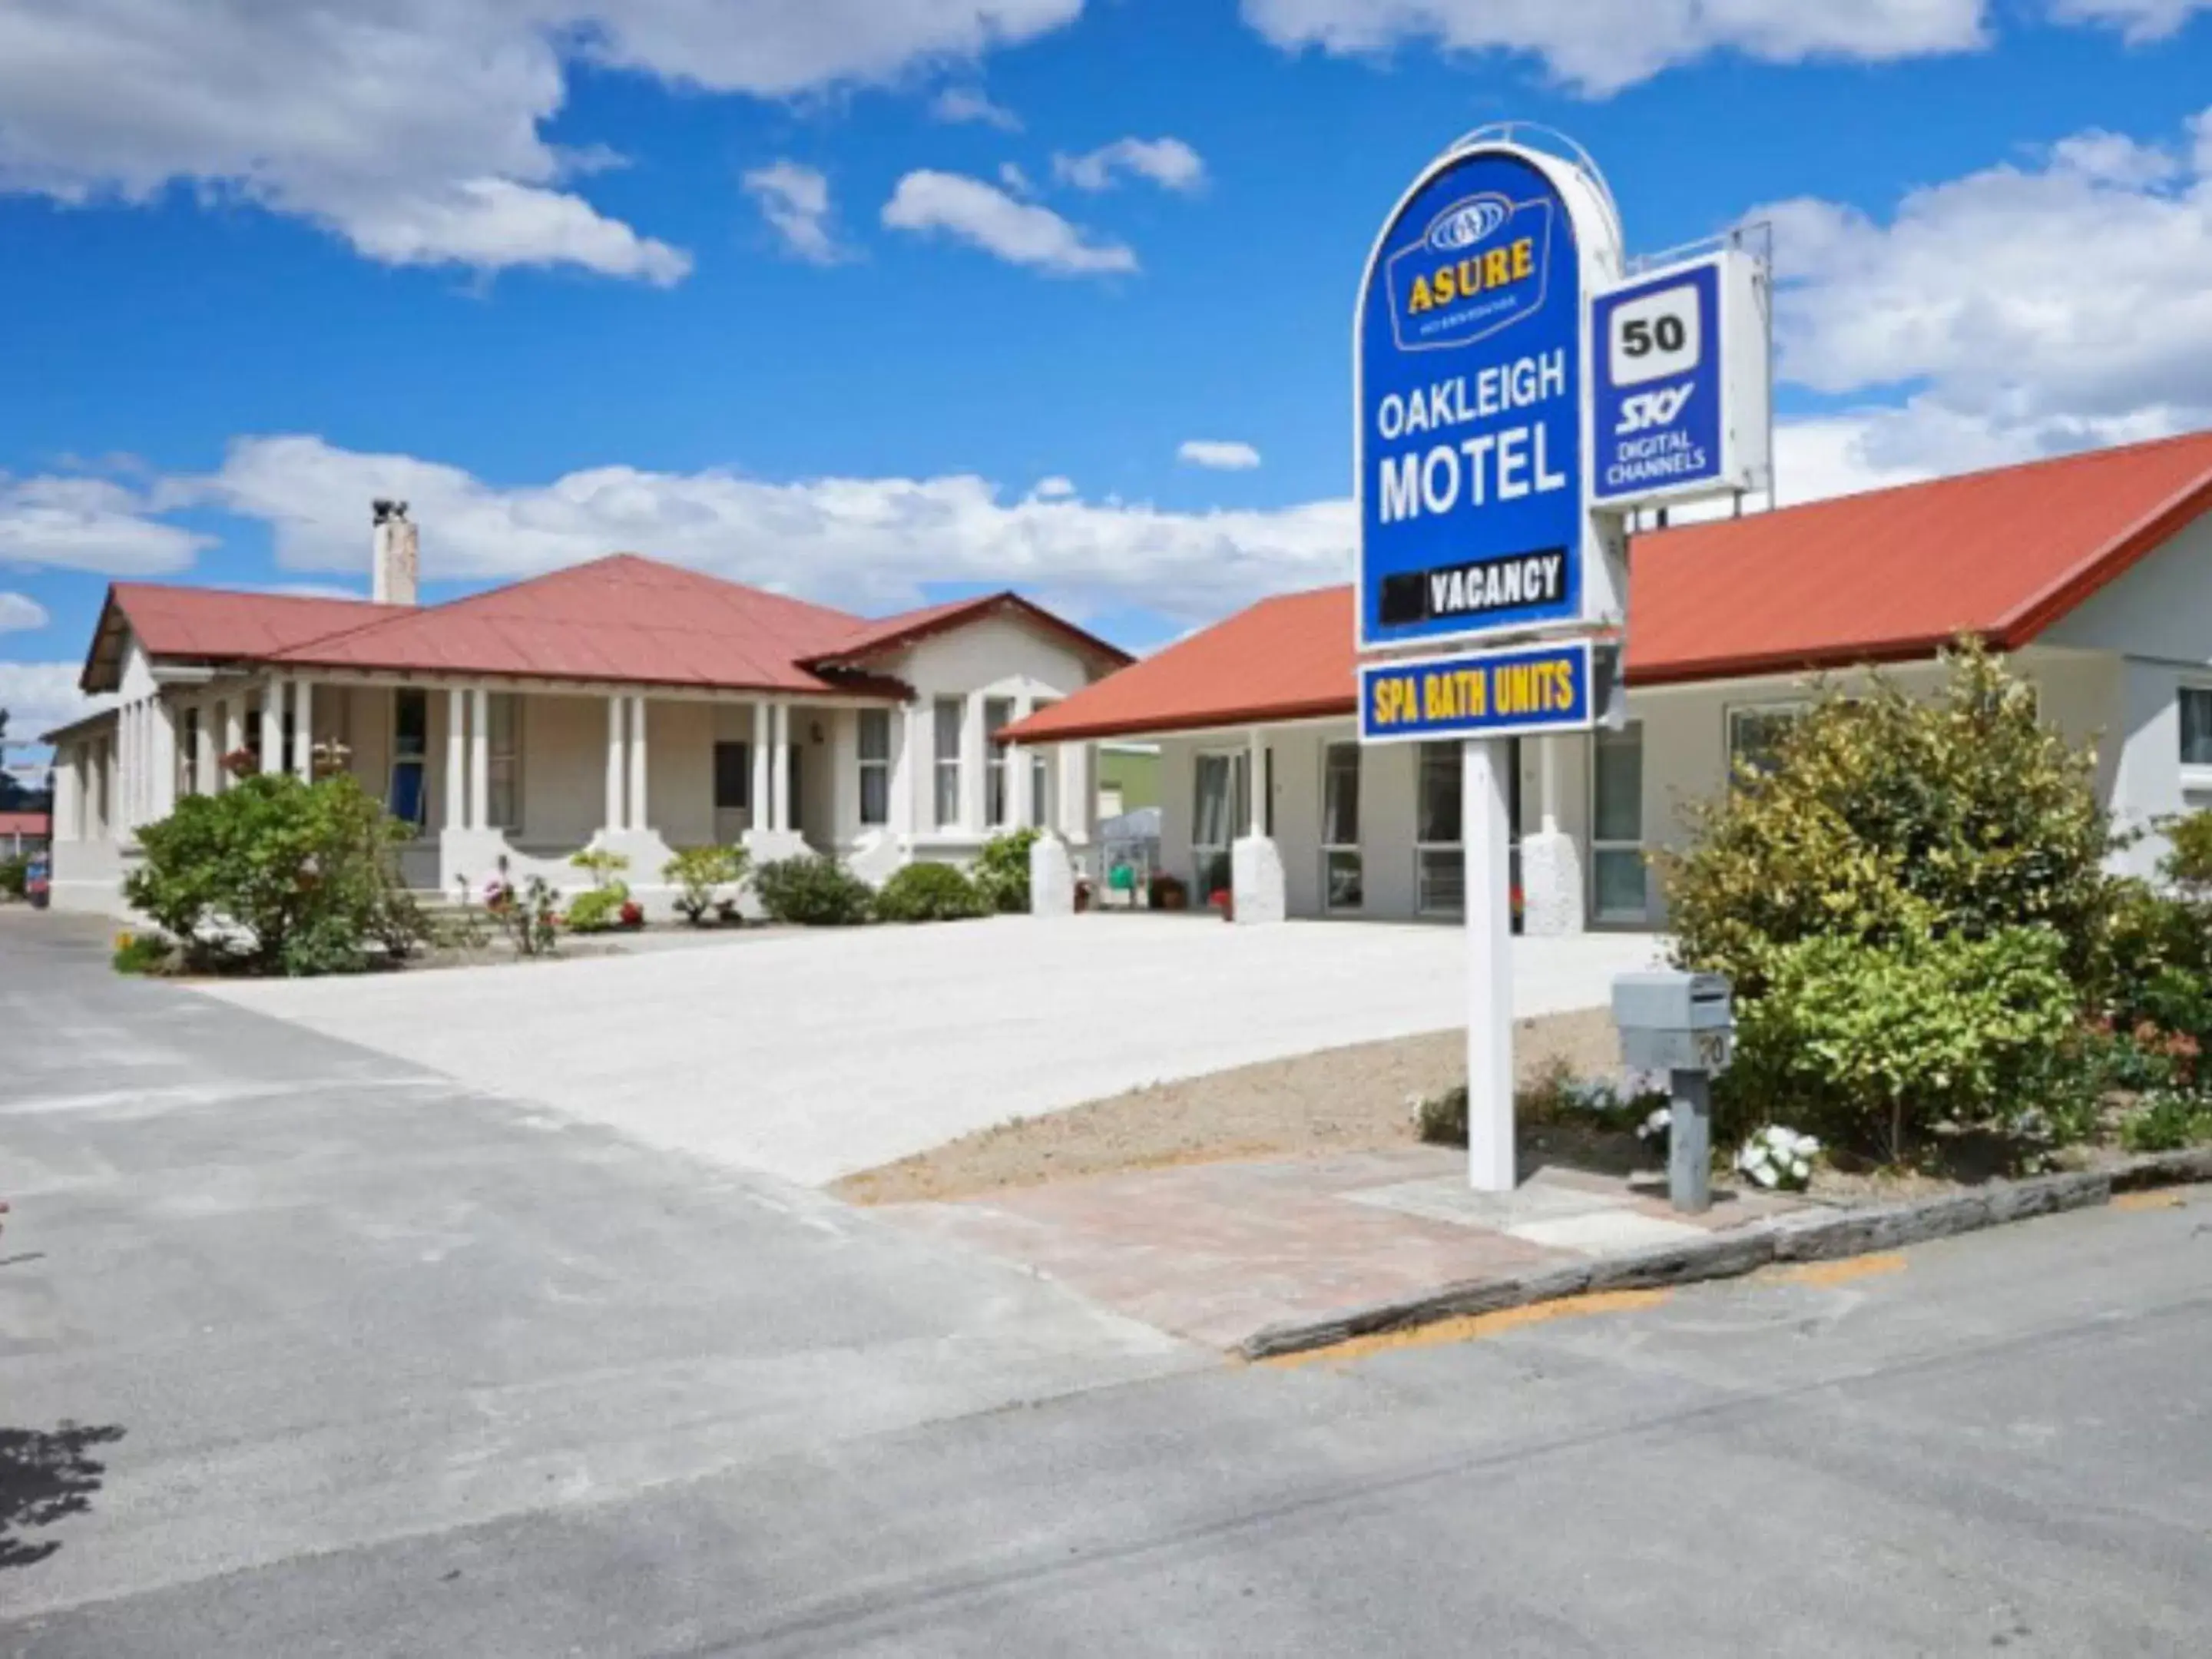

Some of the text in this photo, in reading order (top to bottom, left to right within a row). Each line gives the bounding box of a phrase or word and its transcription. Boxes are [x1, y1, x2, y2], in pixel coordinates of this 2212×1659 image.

[1409, 240, 1532, 313] ASURE
[1622, 316, 1685, 357] 50
[1379, 349, 1565, 439] OAKLEIGH
[1616, 383, 1694, 434] SKY
[1379, 422, 1565, 524] MOTEL
[1606, 449, 1706, 485] CHANNELS
[1618, 432, 1691, 459] DIGITAL
[1430, 555, 1561, 612] VACANCY
[1374, 660, 1574, 723] SPA BATH UNITS
